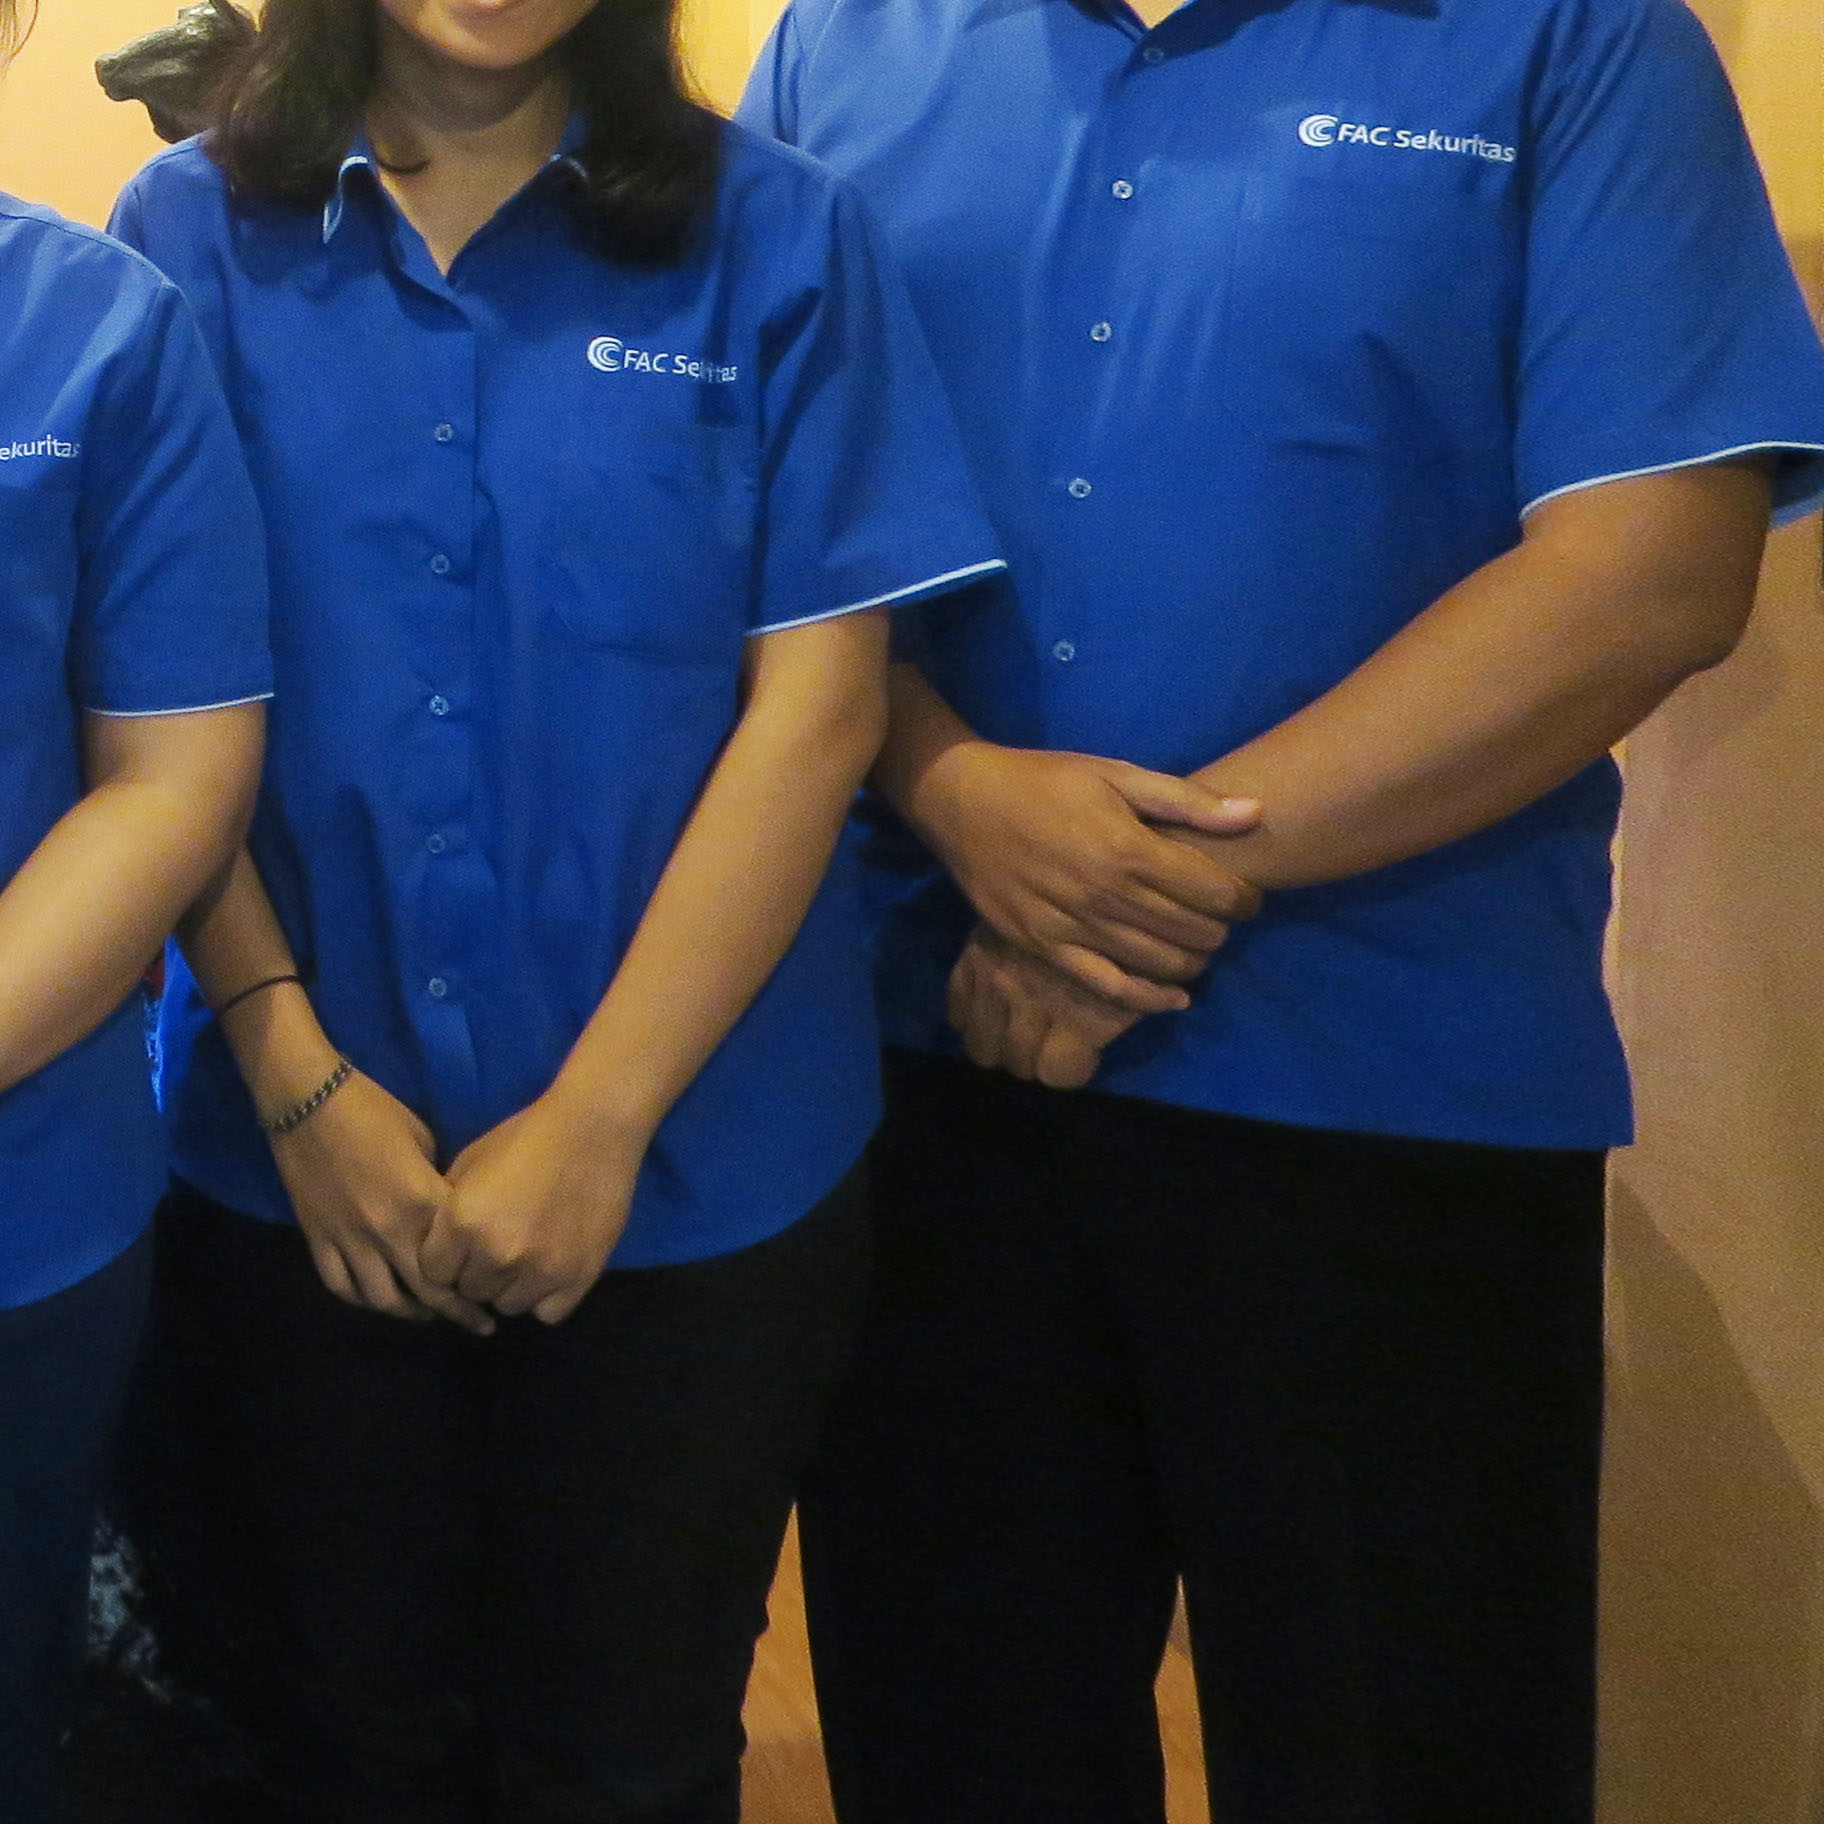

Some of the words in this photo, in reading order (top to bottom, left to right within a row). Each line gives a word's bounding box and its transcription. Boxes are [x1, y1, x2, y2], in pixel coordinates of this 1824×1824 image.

[1337, 122, 1392, 147] FAC
[1393, 129, 1518, 163] Sekuritas
[623, 348, 669, 374] FAC
